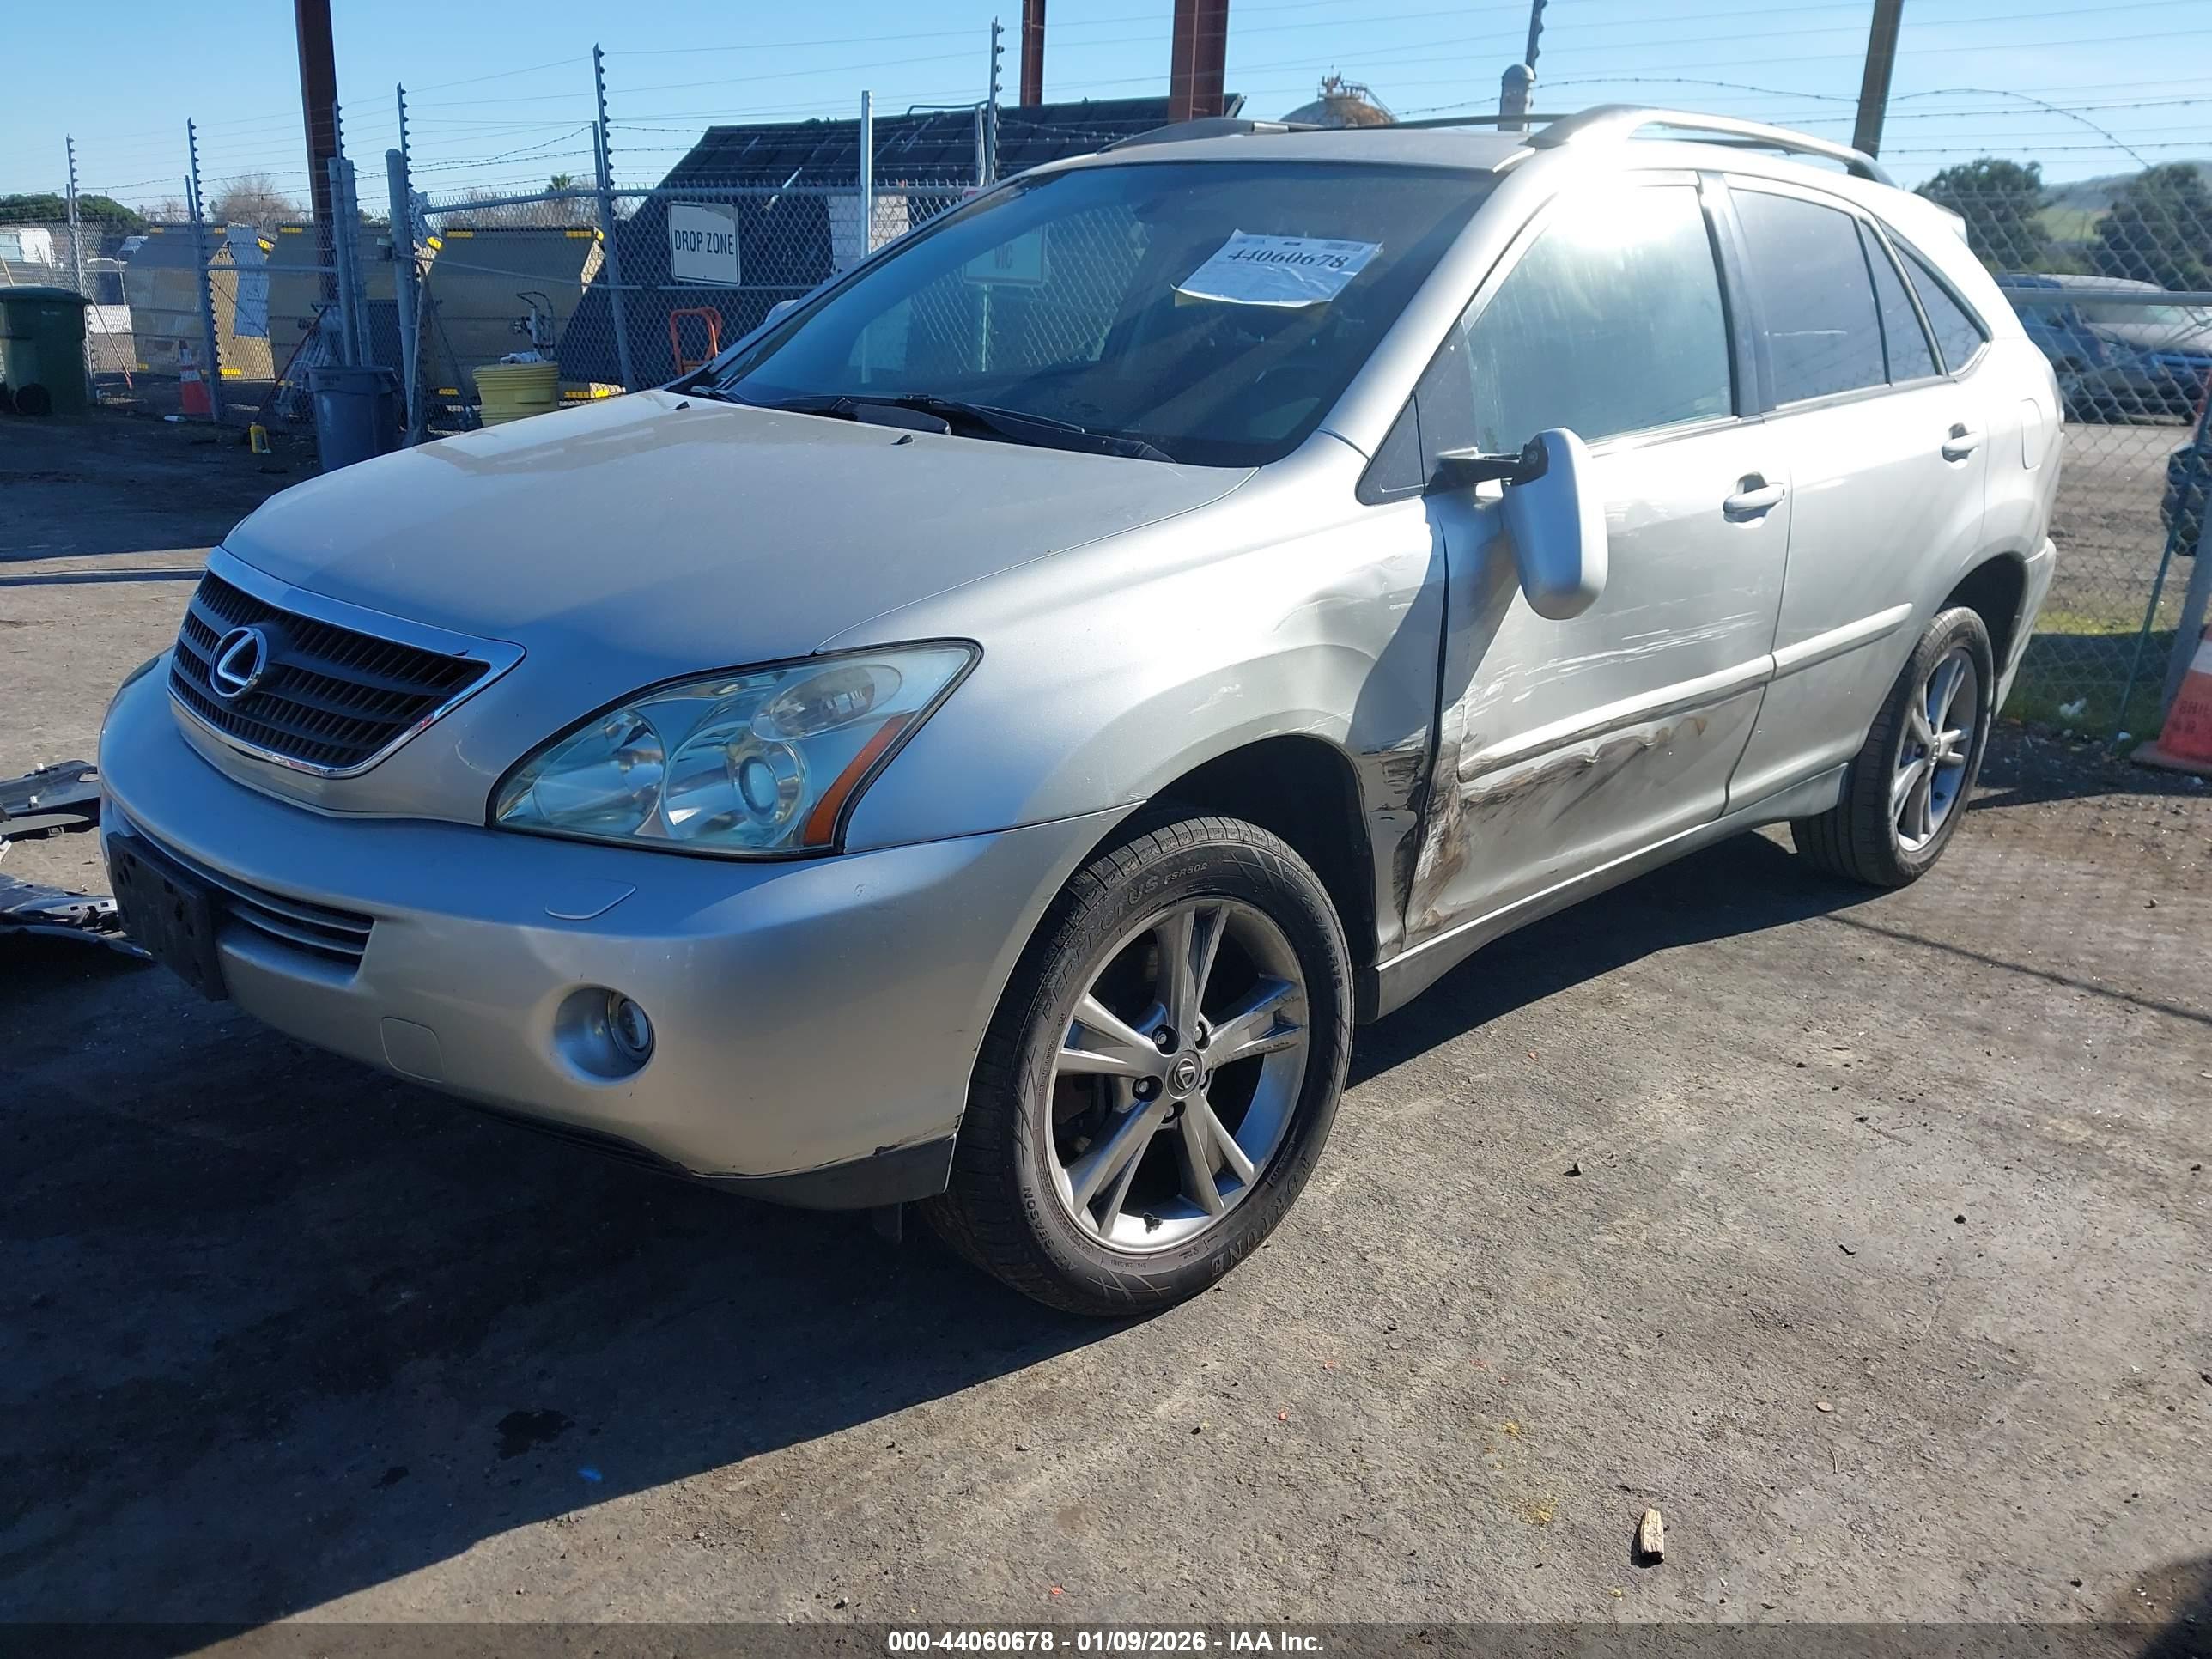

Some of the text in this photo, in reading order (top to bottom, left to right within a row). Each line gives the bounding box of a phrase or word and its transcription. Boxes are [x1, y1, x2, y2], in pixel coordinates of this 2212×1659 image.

[674, 229, 734, 255] DROP ZONE
[1227, 248, 1350, 269] 44060678
[1023, 1185, 1055, 1249] SEASON
